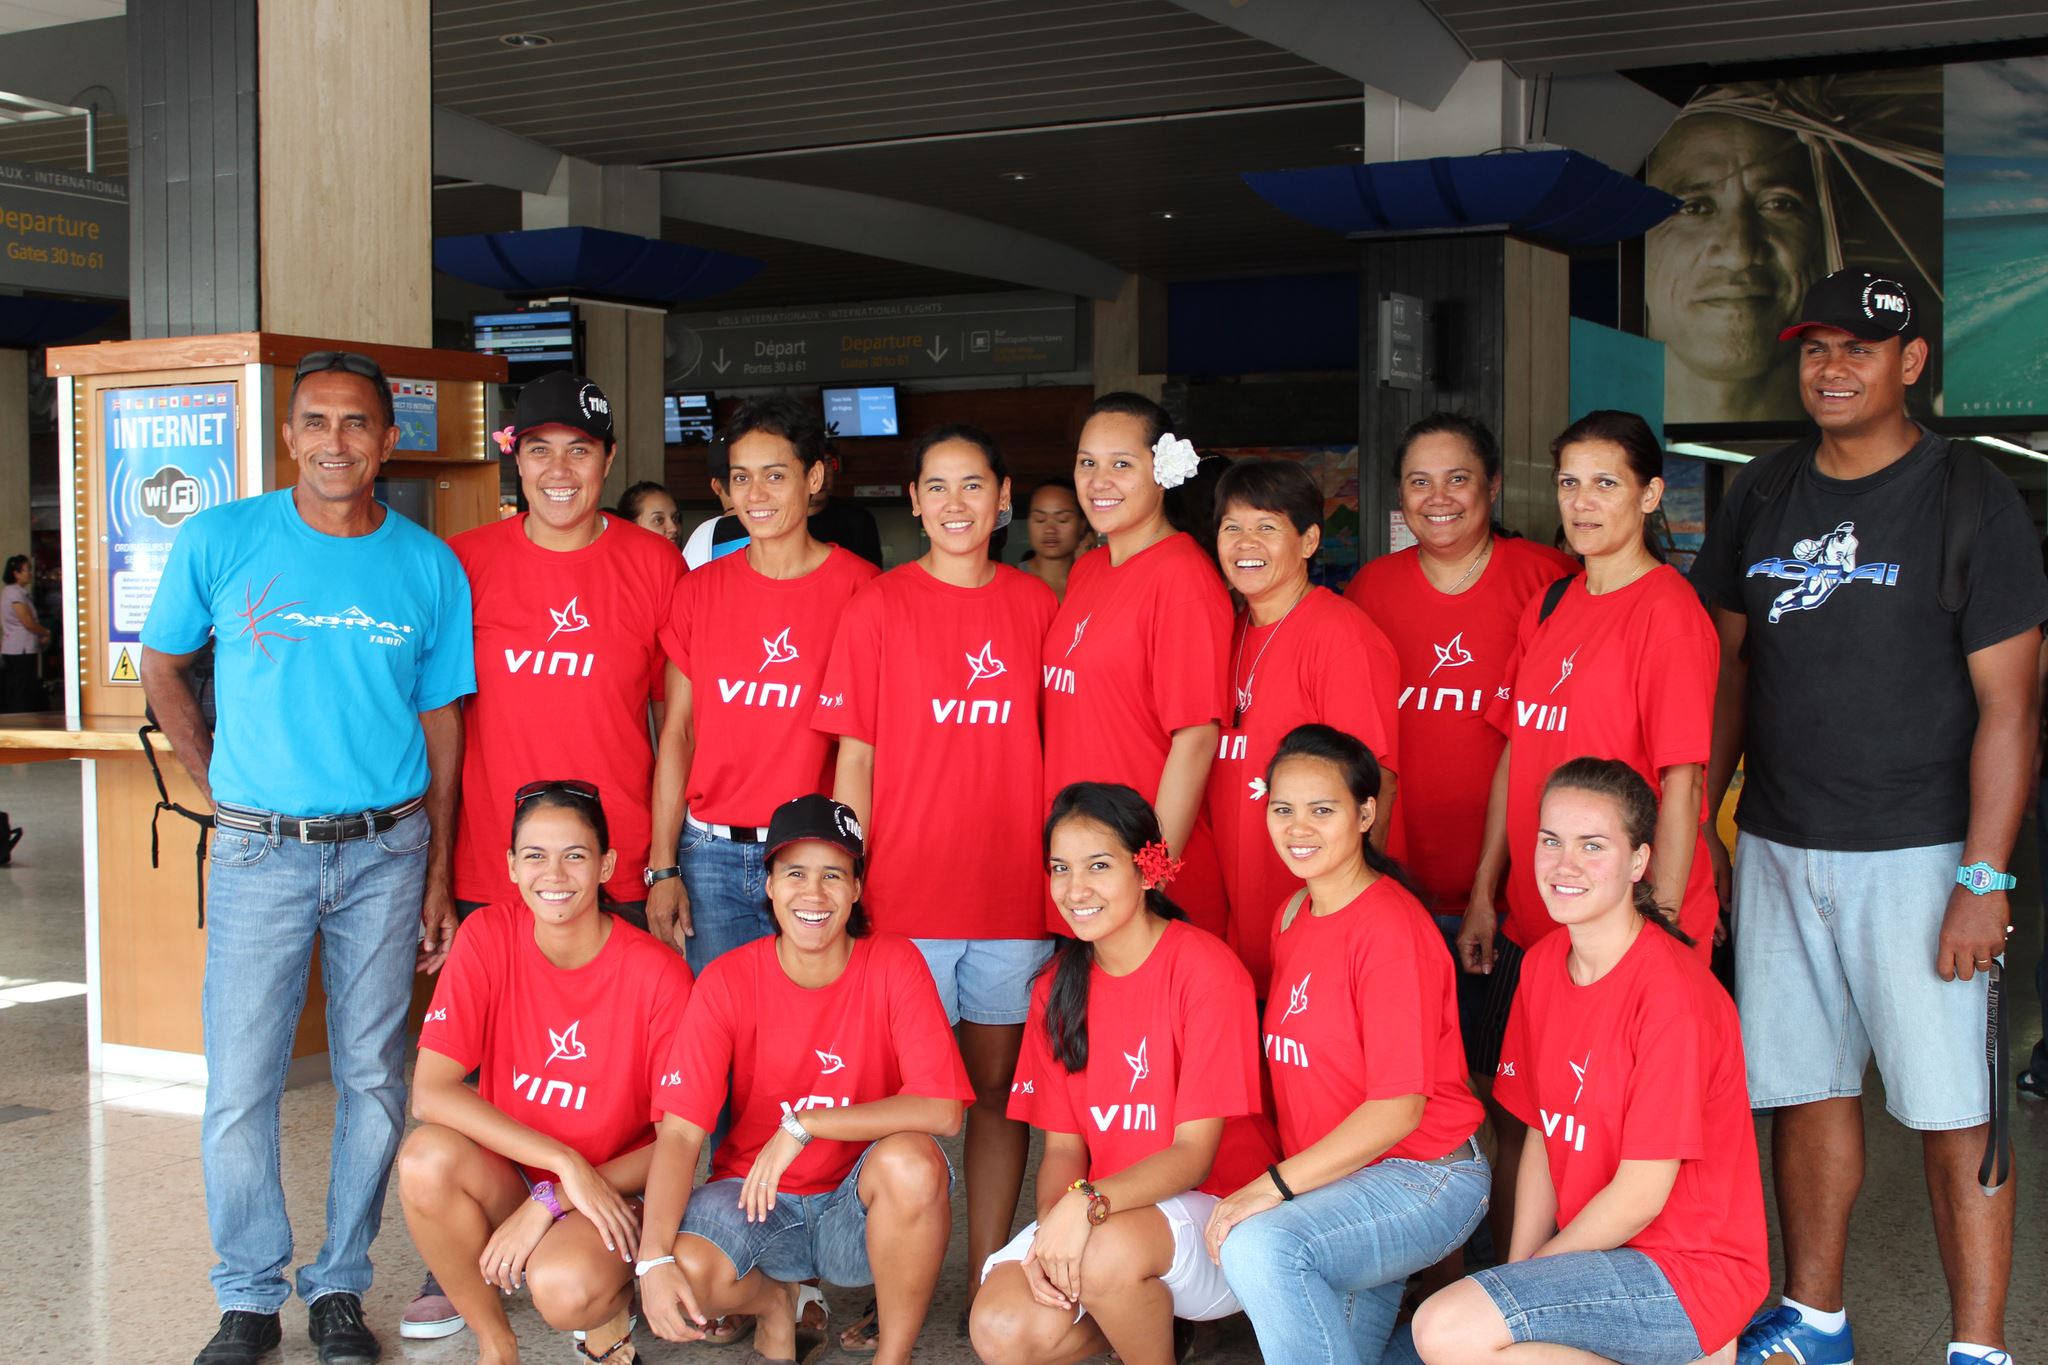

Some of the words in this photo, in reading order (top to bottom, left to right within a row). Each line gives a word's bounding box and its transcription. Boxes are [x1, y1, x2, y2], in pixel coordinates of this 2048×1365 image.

[34, 171, 126, 197] INTERNATIONAL
[7, 241, 48, 263] Gates
[51, 247, 68, 265] 30
[71, 249, 86, 267] to
[88, 251, 105, 270] 61
[717, 316, 739, 327] VOLS
[741, 310, 819, 325] INTERNATIONAUX
[828, 305, 901, 319] INTERNATIONAL
[903, 302, 943, 314] FLIGHTS
[1874, 294, 1904, 313] TNS
[754, 338, 807, 358] Départ
[840, 334, 923, 355] Departure
[743, 361, 773, 375] Portes
[774, 360, 785, 374] 30
[795, 360, 806, 373] 61
[588, 396, 609, 415] TNS
[113, 412, 227, 449] INTERNET
[504, 649, 595, 677] VINI
[717, 678, 801, 708] VINI
[932, 698, 1011, 724] VINI
